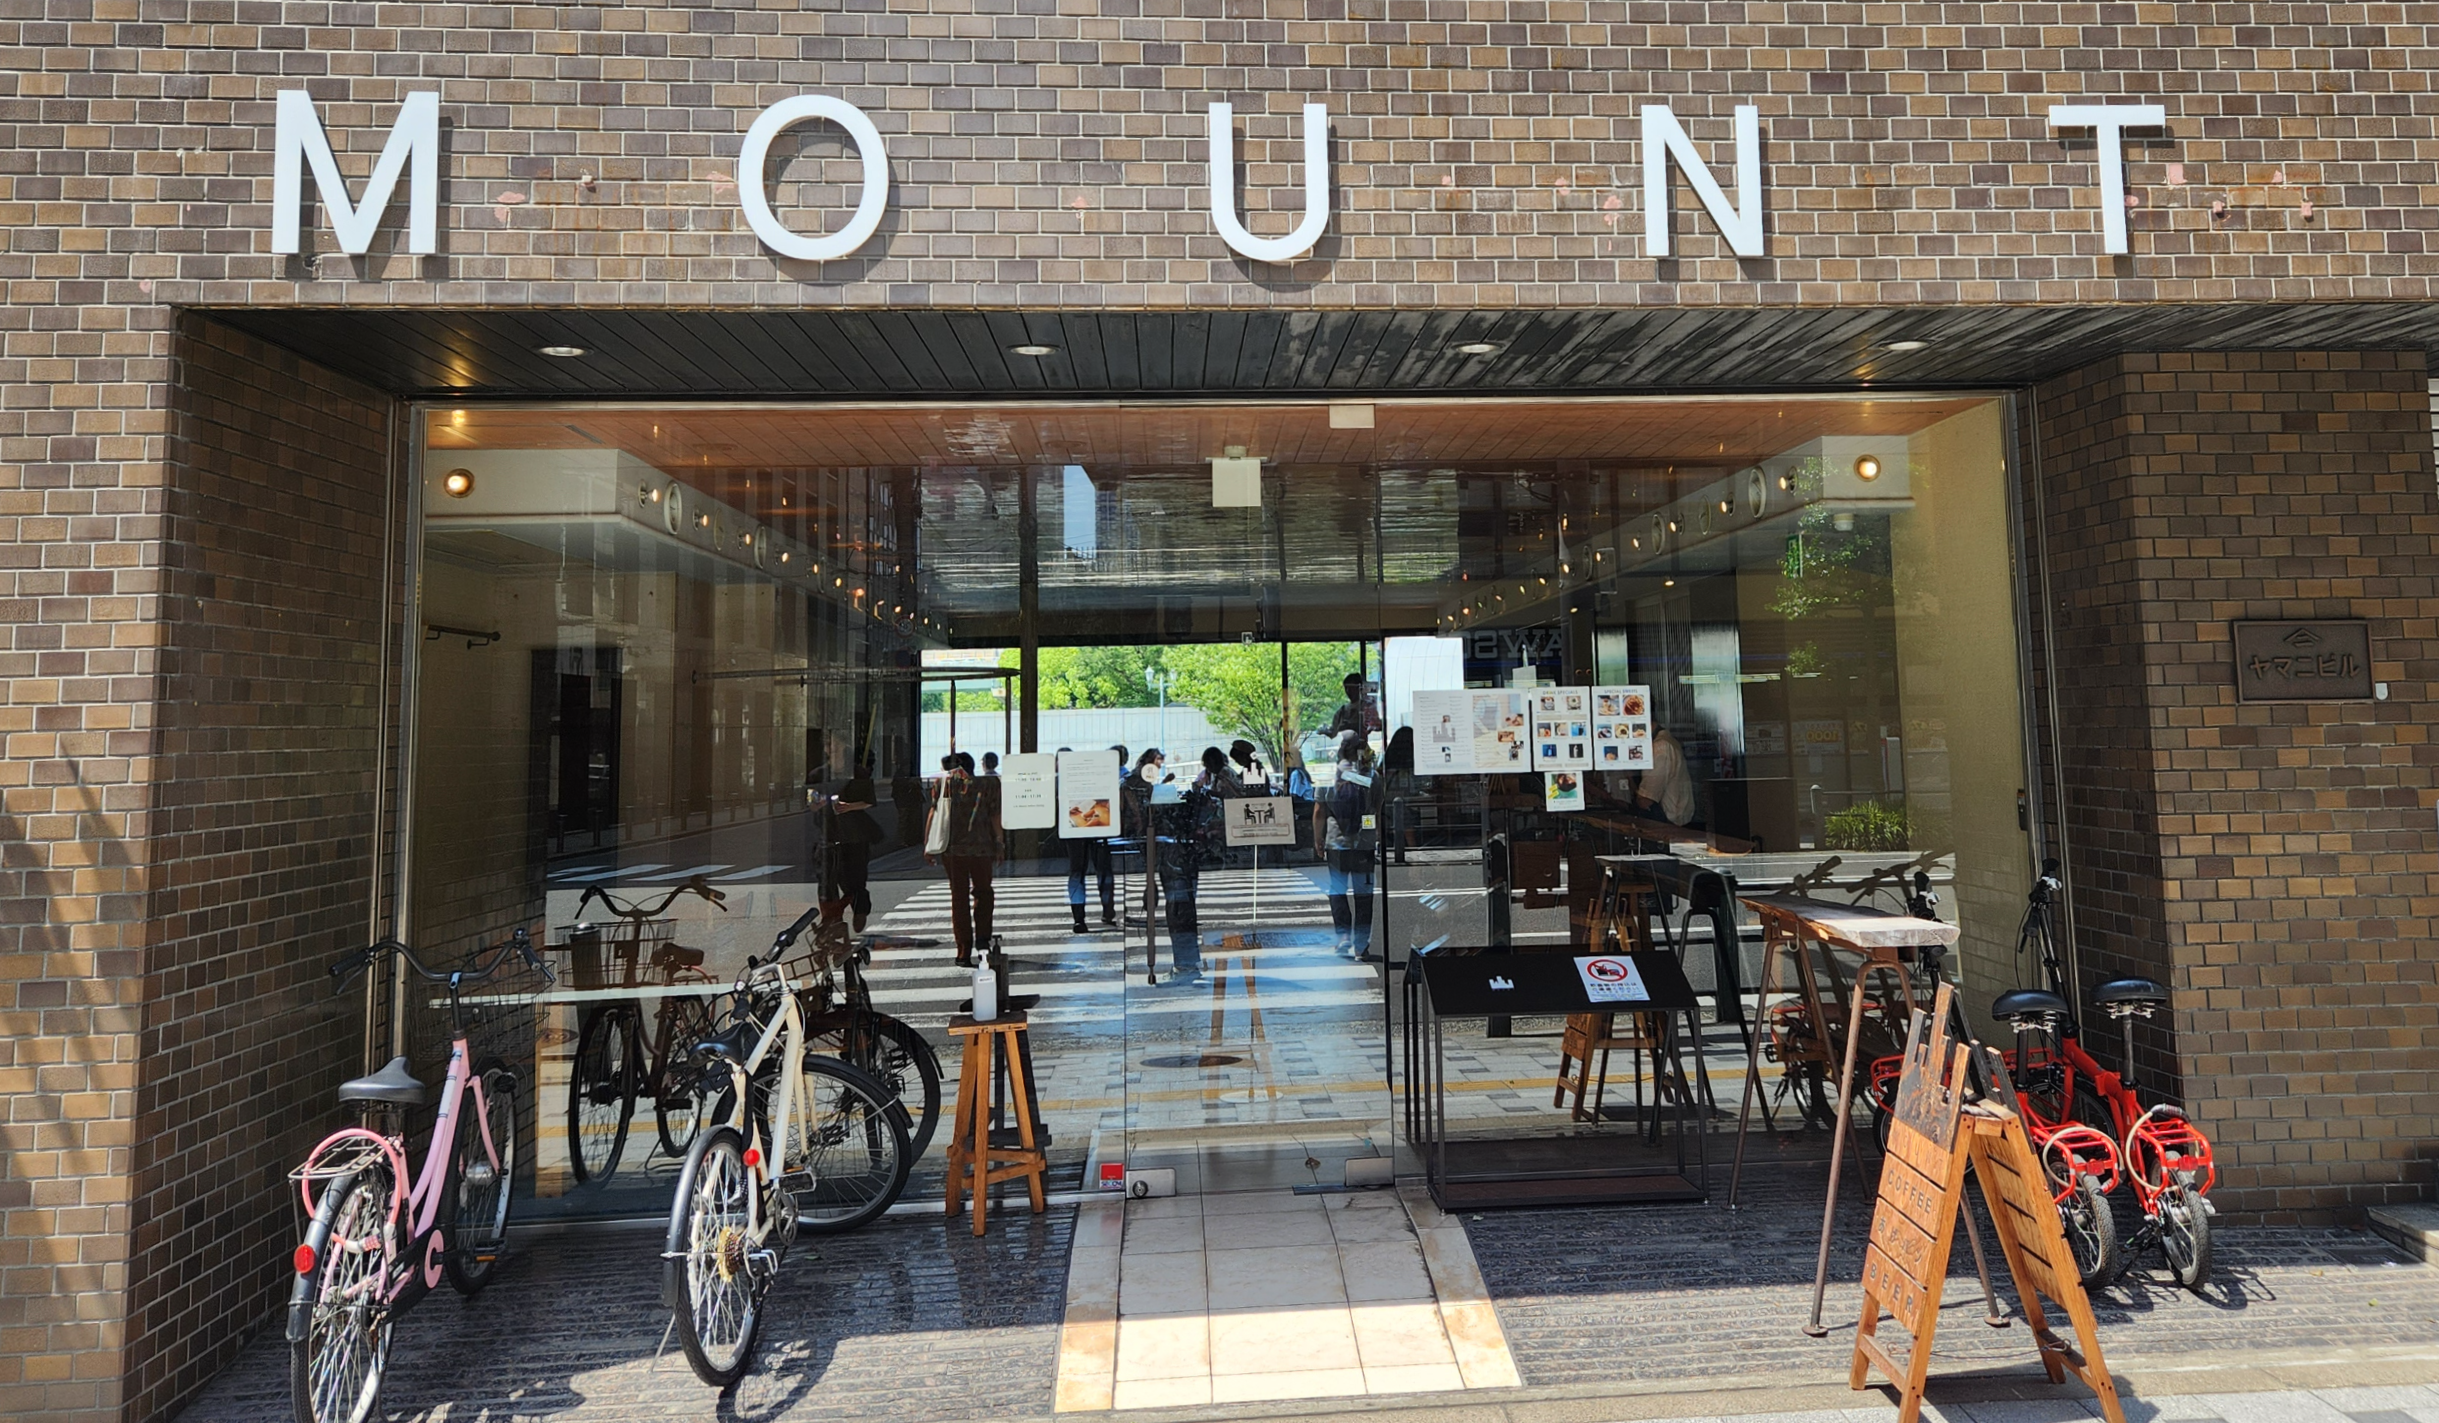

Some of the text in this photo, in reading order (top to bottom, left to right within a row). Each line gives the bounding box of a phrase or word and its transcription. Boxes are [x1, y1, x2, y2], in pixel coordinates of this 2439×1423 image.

[272, 89, 2166, 262] MOUNT
[2250, 653, 2361, 680] ヤマニビル
[1887, 1169, 1932, 1213] COFFEE
[1870, 1263, 1913, 1313] BEER
